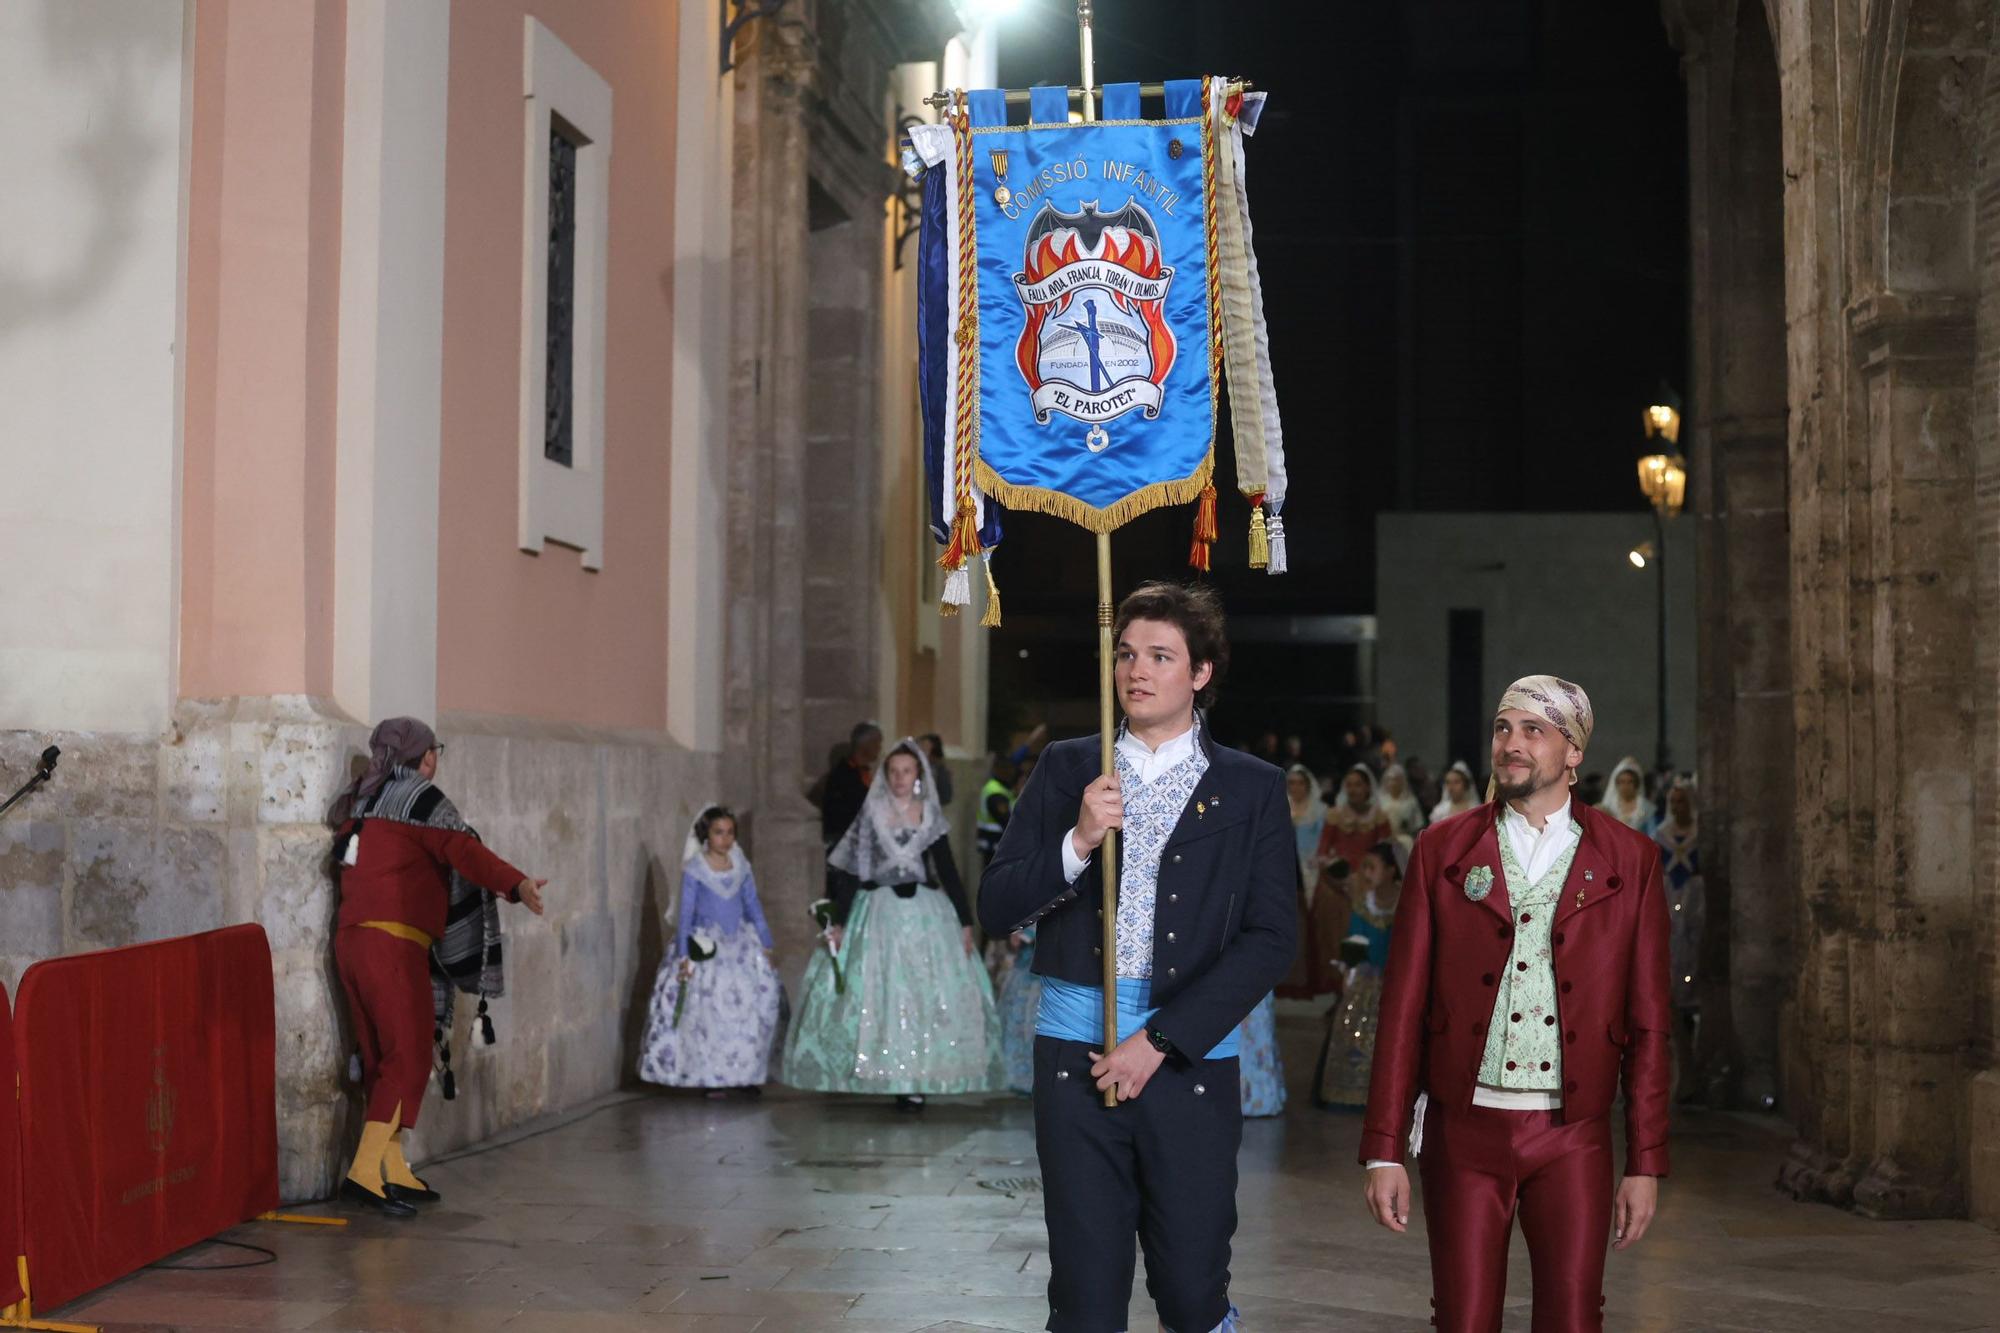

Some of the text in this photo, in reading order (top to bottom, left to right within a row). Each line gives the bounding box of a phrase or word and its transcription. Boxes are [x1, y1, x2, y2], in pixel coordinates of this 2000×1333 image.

[1002, 153, 1181, 220] COMISSIÓ INFANTIL
[1028, 288, 1048, 300] FALLA
[1105, 270, 1129, 291] TORÁN
[1129, 281, 1134, 294] I
[1134, 282, 1159, 296] OLMOS
[1118, 359, 1139, 367] 2002
